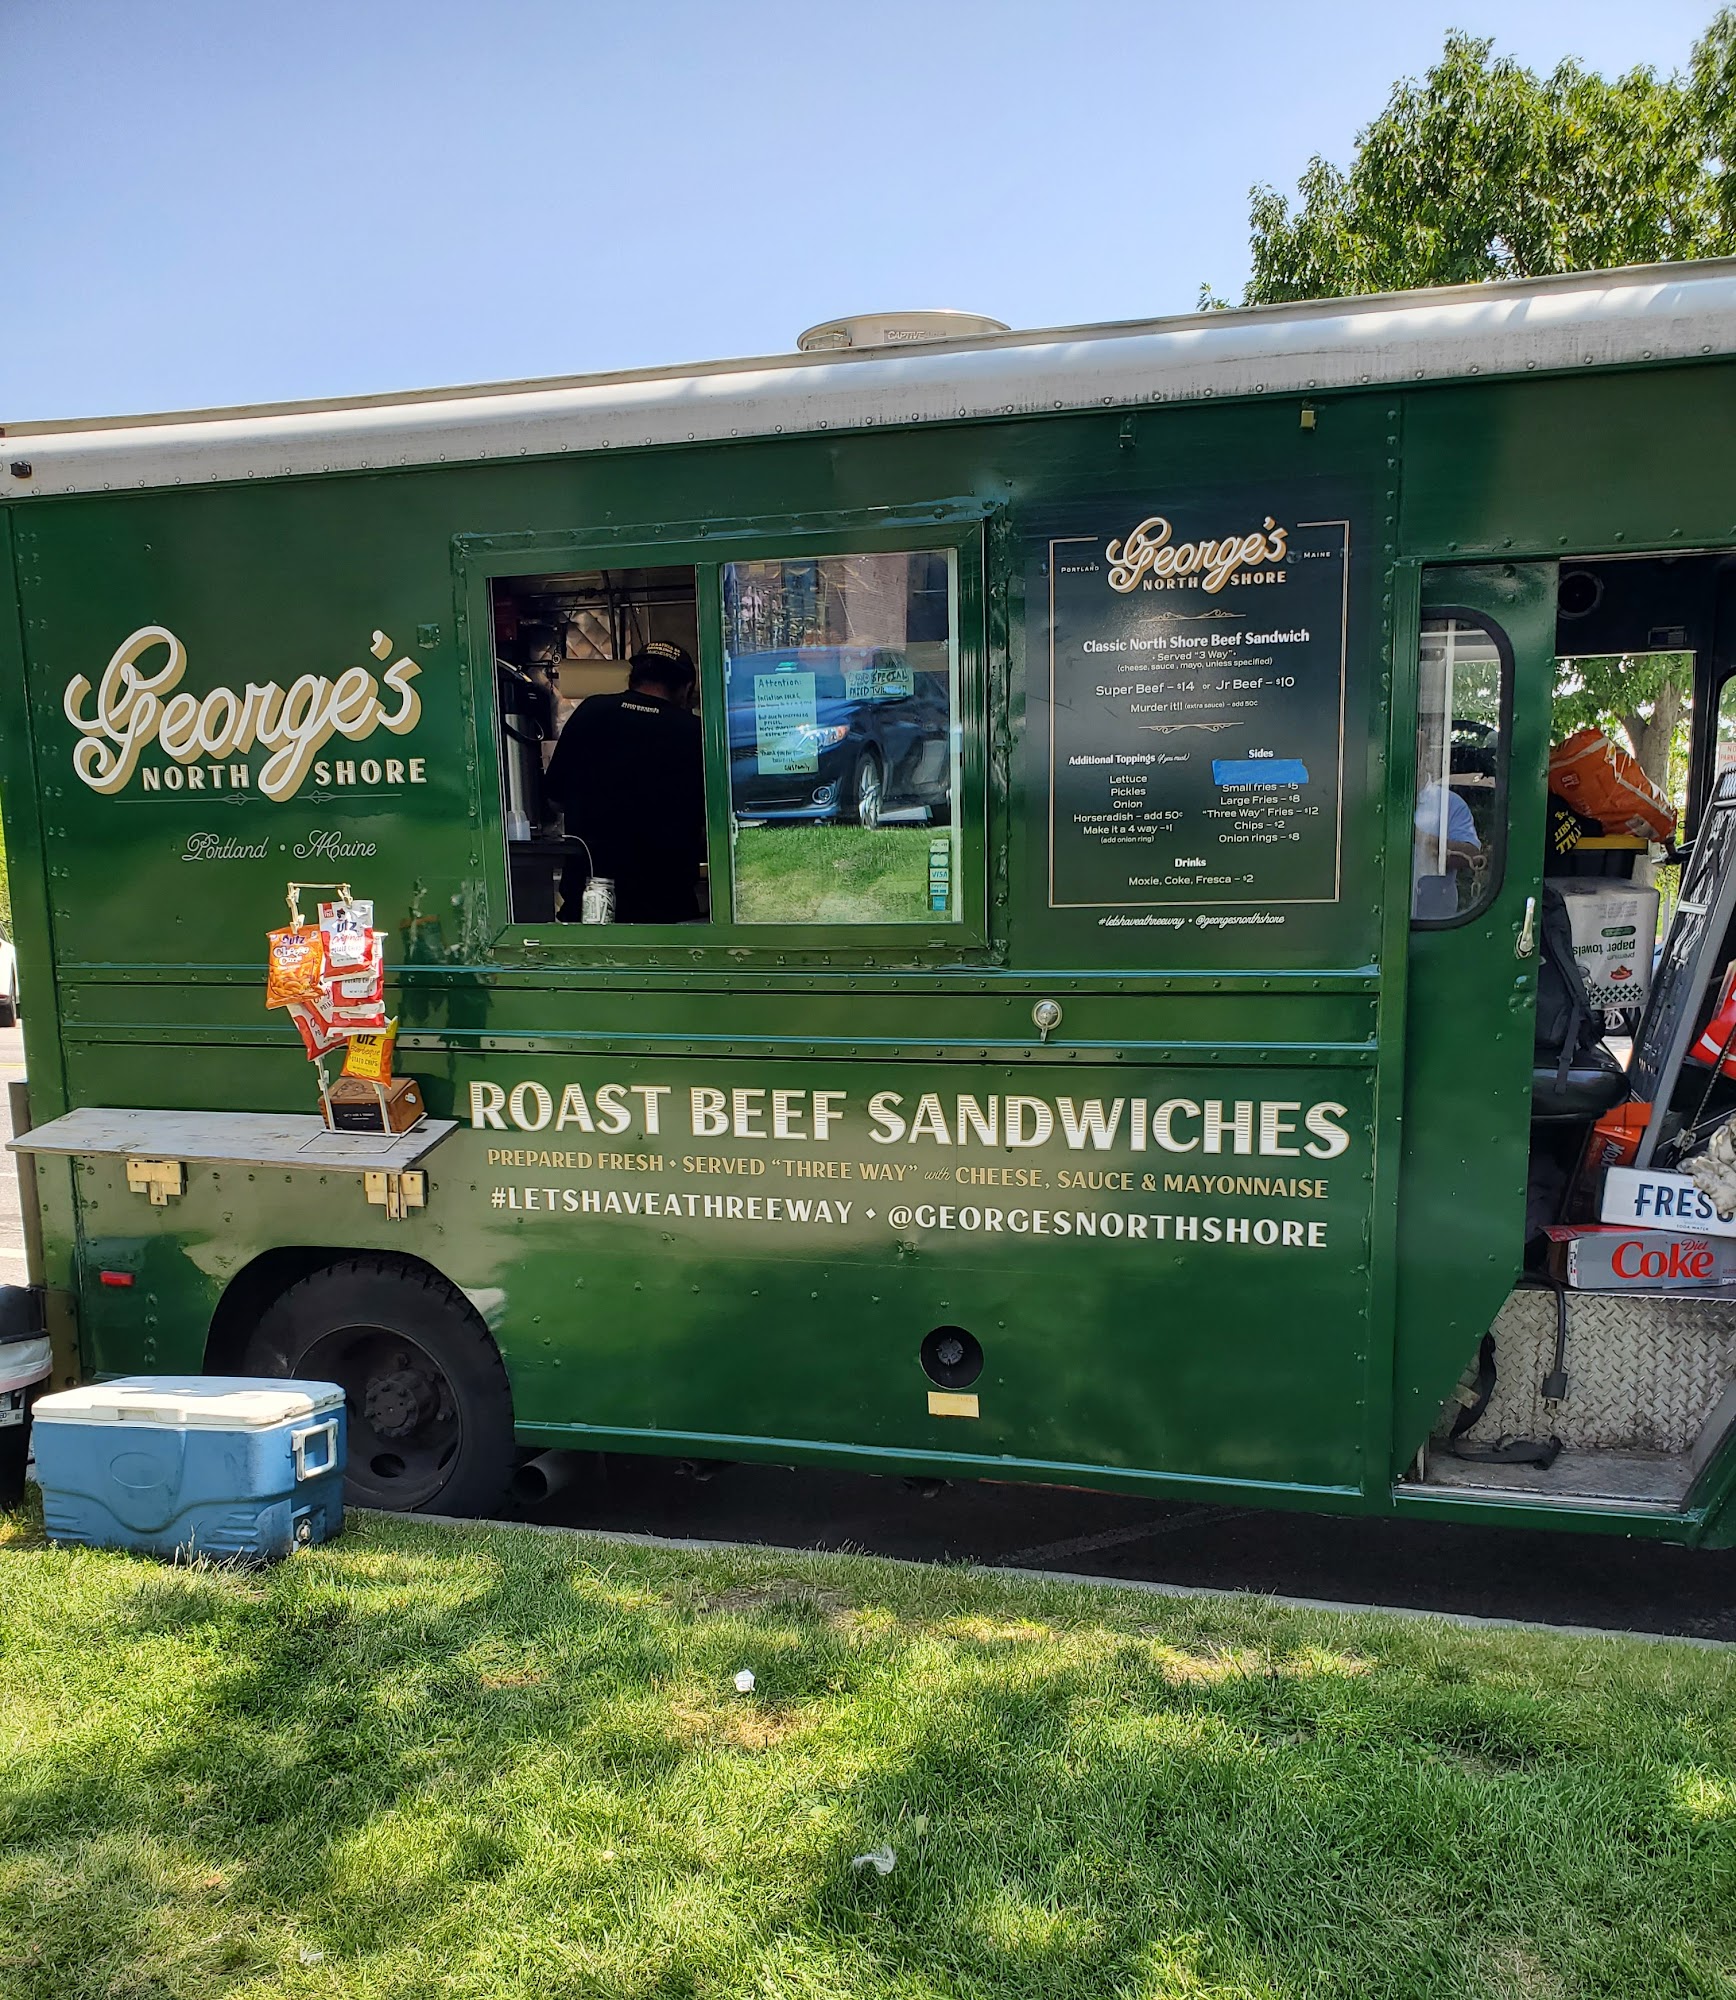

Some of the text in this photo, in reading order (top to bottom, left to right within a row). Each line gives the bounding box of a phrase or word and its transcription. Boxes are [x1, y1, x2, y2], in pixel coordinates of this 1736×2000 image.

[1105, 515, 1289, 594] George's
[1143, 570, 1287, 591] NORTH SHORE
[1083, 628, 1310, 653] Classic North Shore Beef Sandwich
[1157, 652, 1192, 661] Served
[1233, 657, 1273, 667] specified)
[871, 668, 909, 682] SPECIAL
[759, 679, 802, 688] Attention:
[1095, 685, 1134, 697] Super
[1136, 682, 1165, 694] Beef
[1177, 681, 1195, 692] $14
[1215, 680, 1230, 690] Jr
[1233, 678, 1263, 689] Beef
[1275, 677, 1295, 687] $10
[1130, 702, 1168, 713] Murder
[63, 625, 423, 803] George's
[1248, 748, 1274, 758] Sides
[1068, 754, 1113, 765] Additional
[1115, 753, 1155, 765] Toppings
[142, 757, 427, 792] NORTH SHORE
[1109, 775, 1147, 784] Lettuce
[1110, 787, 1146, 796] Pickles
[1222, 784, 1251, 792] Small
[1253, 783, 1277, 791] fries
[1113, 800, 1143, 809] Onion
[1220, 794, 1300, 806] Large Fries $8
[1073, 812, 1133, 822] Horseradish
[1144, 811, 1162, 820] add
[1267, 807, 1294, 816] Fries
[1304, 807, 1319, 815] $12
[1083, 825, 1110, 834] Make
[1111, 825, 1118, 833] it
[1127, 825, 1135, 833] 4
[1137, 825, 1158, 834] way
[1234, 820, 1285, 831] Chips $2
[1101, 836, 1116, 844] (add
[1137, 835, 1155, 844] ring)
[1219, 832, 1300, 843] Onion rings $8
[181, 830, 377, 862] Portland Maine
[1174, 857, 1207, 867] Drinks
[1195, 875, 1232, 884] Fresca
[1242, 874, 1254, 883] $2
[1098, 912, 1285, 929] #letshaveathreeway @georgesnorthshore
[1572, 938, 1636, 957] paper towels
[469, 1080, 1350, 1160] ROAST BEEF SANDWICHES
[488, 1149, 593, 1169] PREPARED
[598, 1152, 664, 1172] FRESH
[682, 1155, 765, 1176] SERVED
[924, 1166, 951, 1181] with
[955, 1166, 1050, 1190] CHEESE,
[1057, 1170, 1134, 1192] SAUCE
[1141, 1173, 1157, 1192] &
[1164, 1173, 1329, 1200] MAYONNAISE
[491, 1186, 1328, 1248] #LETSHAVEATHREEWAY @GEORGESNORTHSHORE
[1680, 1239, 1709, 1252] Diet
[1611, 1241, 1715, 1279] Coke
